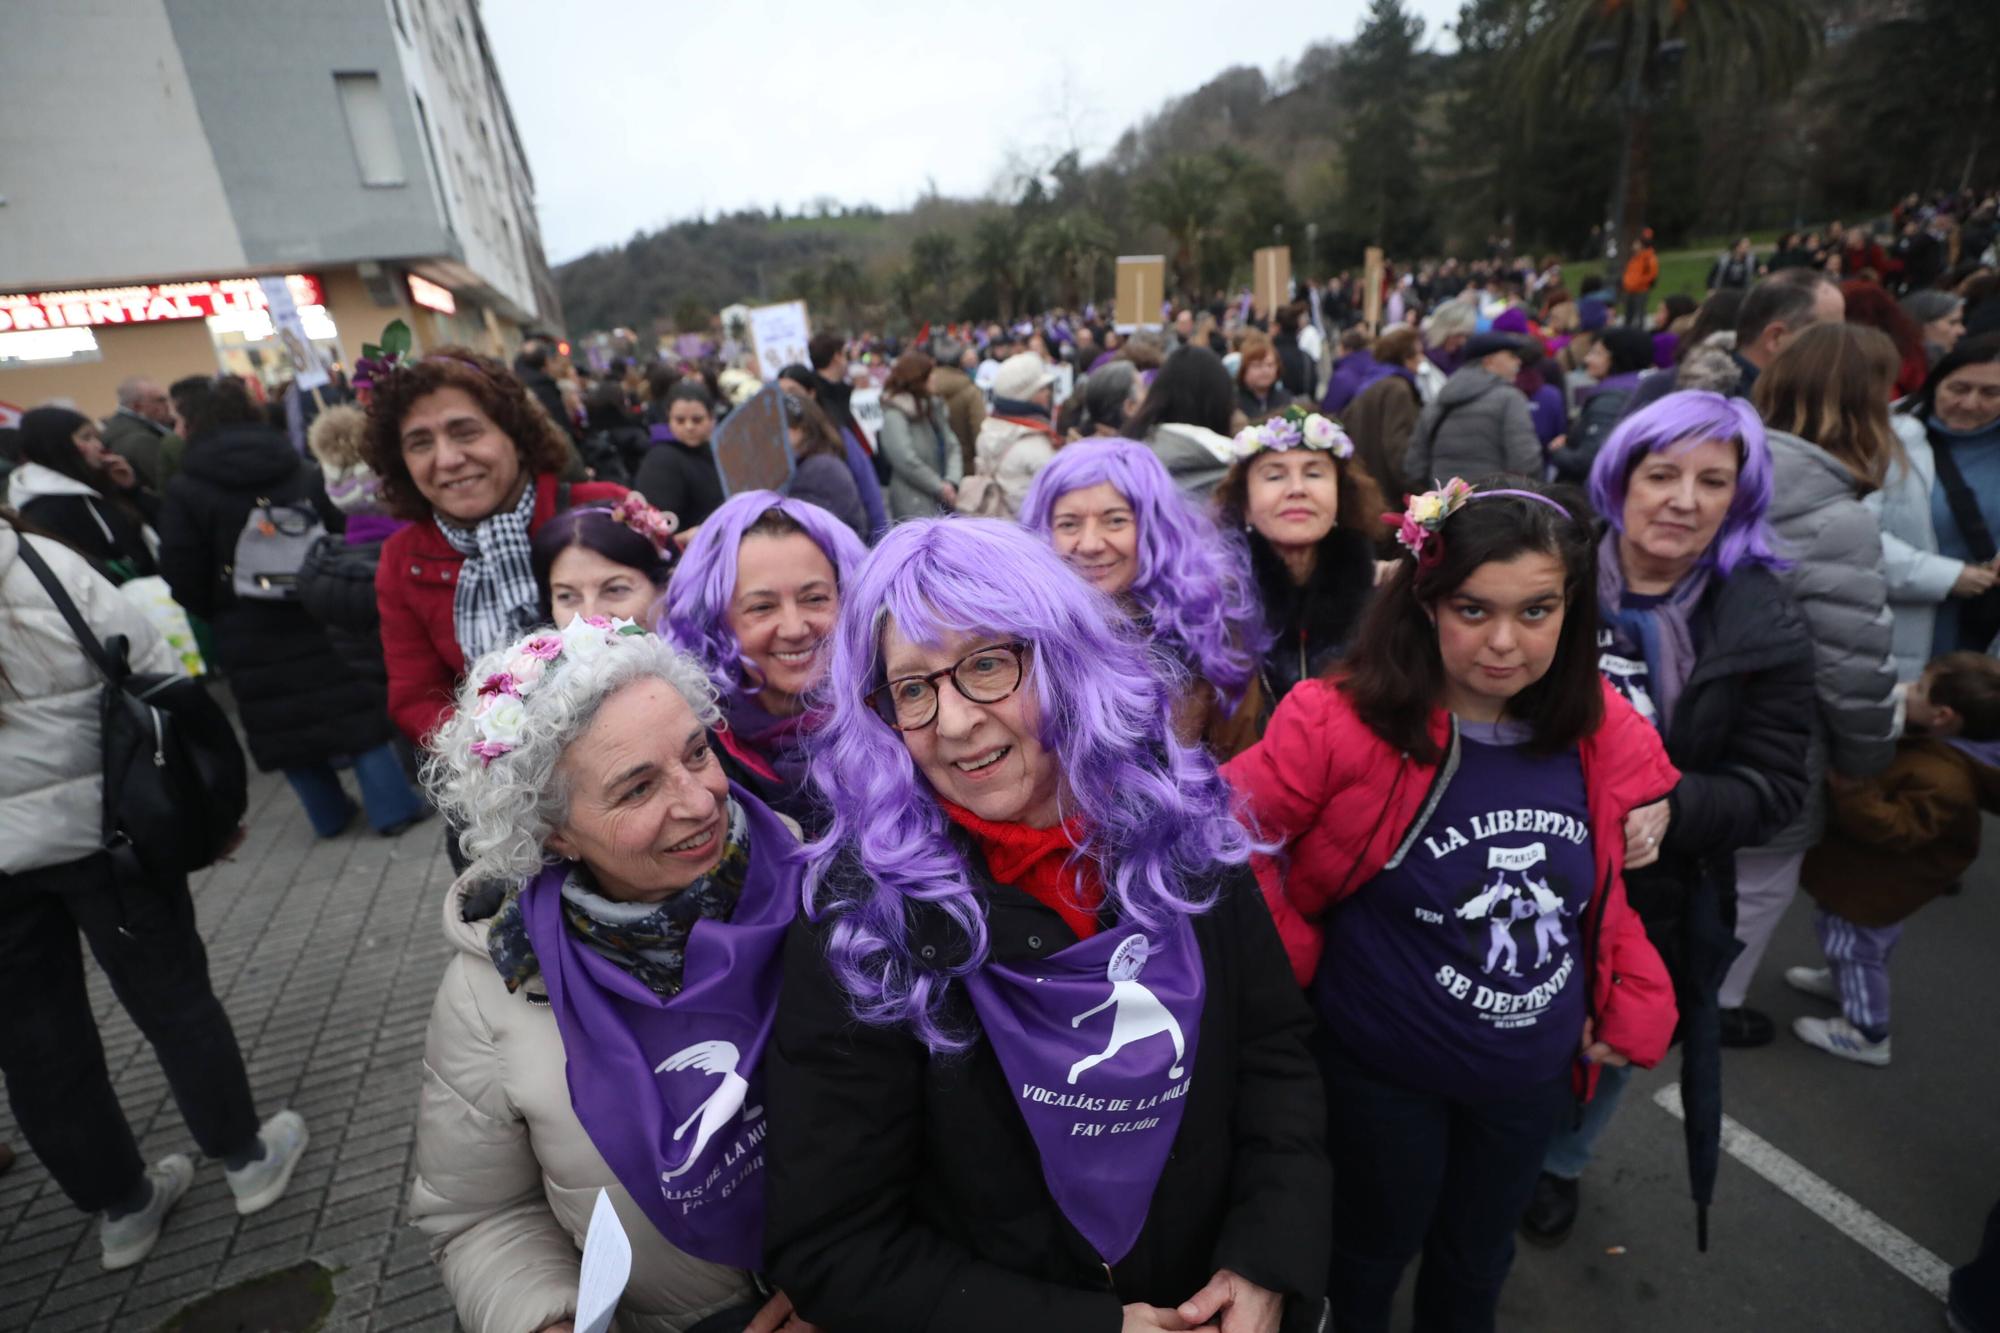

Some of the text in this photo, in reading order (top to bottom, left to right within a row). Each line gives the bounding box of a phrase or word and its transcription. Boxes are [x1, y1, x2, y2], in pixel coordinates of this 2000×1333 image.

[1424, 826, 1469, 859] LA
[1435, 965, 1473, 1000] SE
[1022, 1084, 1104, 1112] VOCALÍAS
[1106, 1099, 1132, 1112] DE
[1136, 1096, 1158, 1111] LA
[1071, 1116, 1160, 1137] FAV GIJÓN
[724, 1141, 746, 1167] LA
